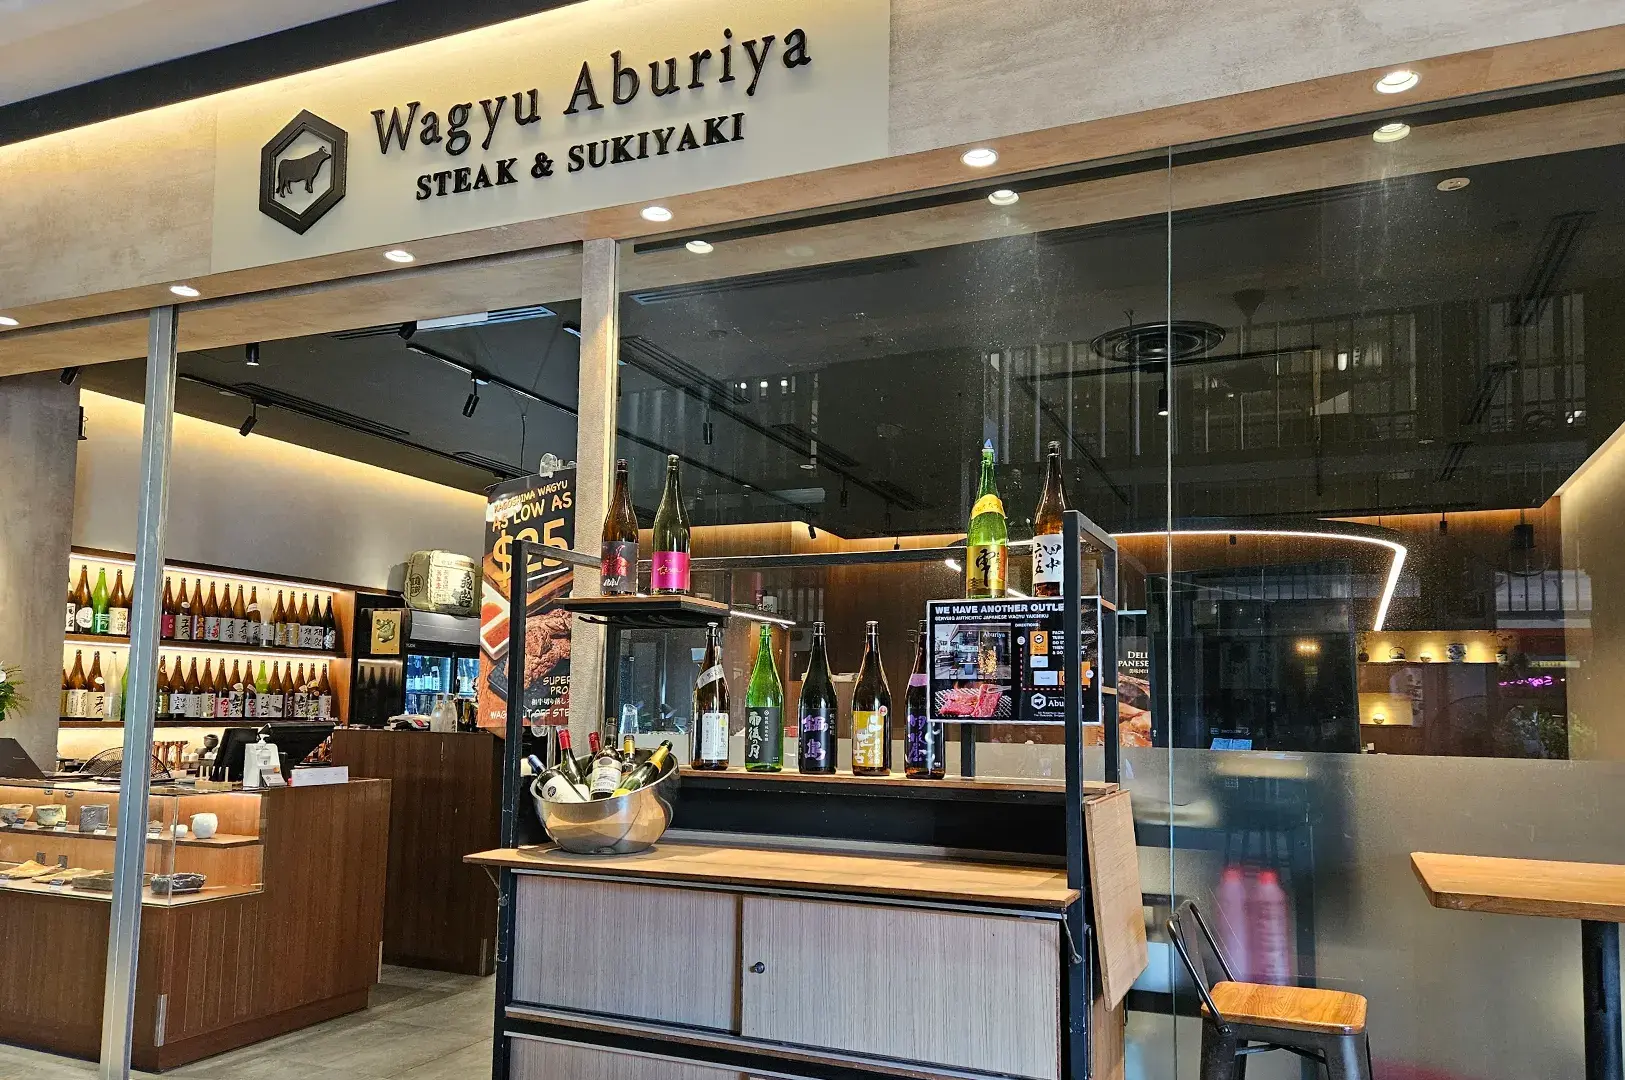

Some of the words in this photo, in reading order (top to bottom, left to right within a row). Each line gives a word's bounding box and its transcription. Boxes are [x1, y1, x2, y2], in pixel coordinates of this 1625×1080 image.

[371, 88, 542, 155] Wagyu
[563, 27, 812, 115] Aburiya
[416, 158, 518, 200] STEAK
[531, 152, 553, 178] &
[567, 112, 746, 172] SUKIYAKI
[537, 480, 568, 496] WAGYU
[492, 516, 508, 532] AS
[514, 498, 545, 524] LOW
[551, 491, 573, 511] AS
[492, 517, 568, 587] $25
[935, 606, 950, 614] WE
[952, 605, 978, 614] HAVE
[980, 604, 1028, 613] ANOTHER
[1030, 603, 1064, 612] OUTLE
[1128, 651, 1148, 659] DELI
[550, 686, 569, 695] PRO
[490, 710, 507, 719] WAG
[553, 708, 570, 718] STE
[748, 711, 762, 760] 雨後の月
[802, 714, 828, 761] 鍋島
